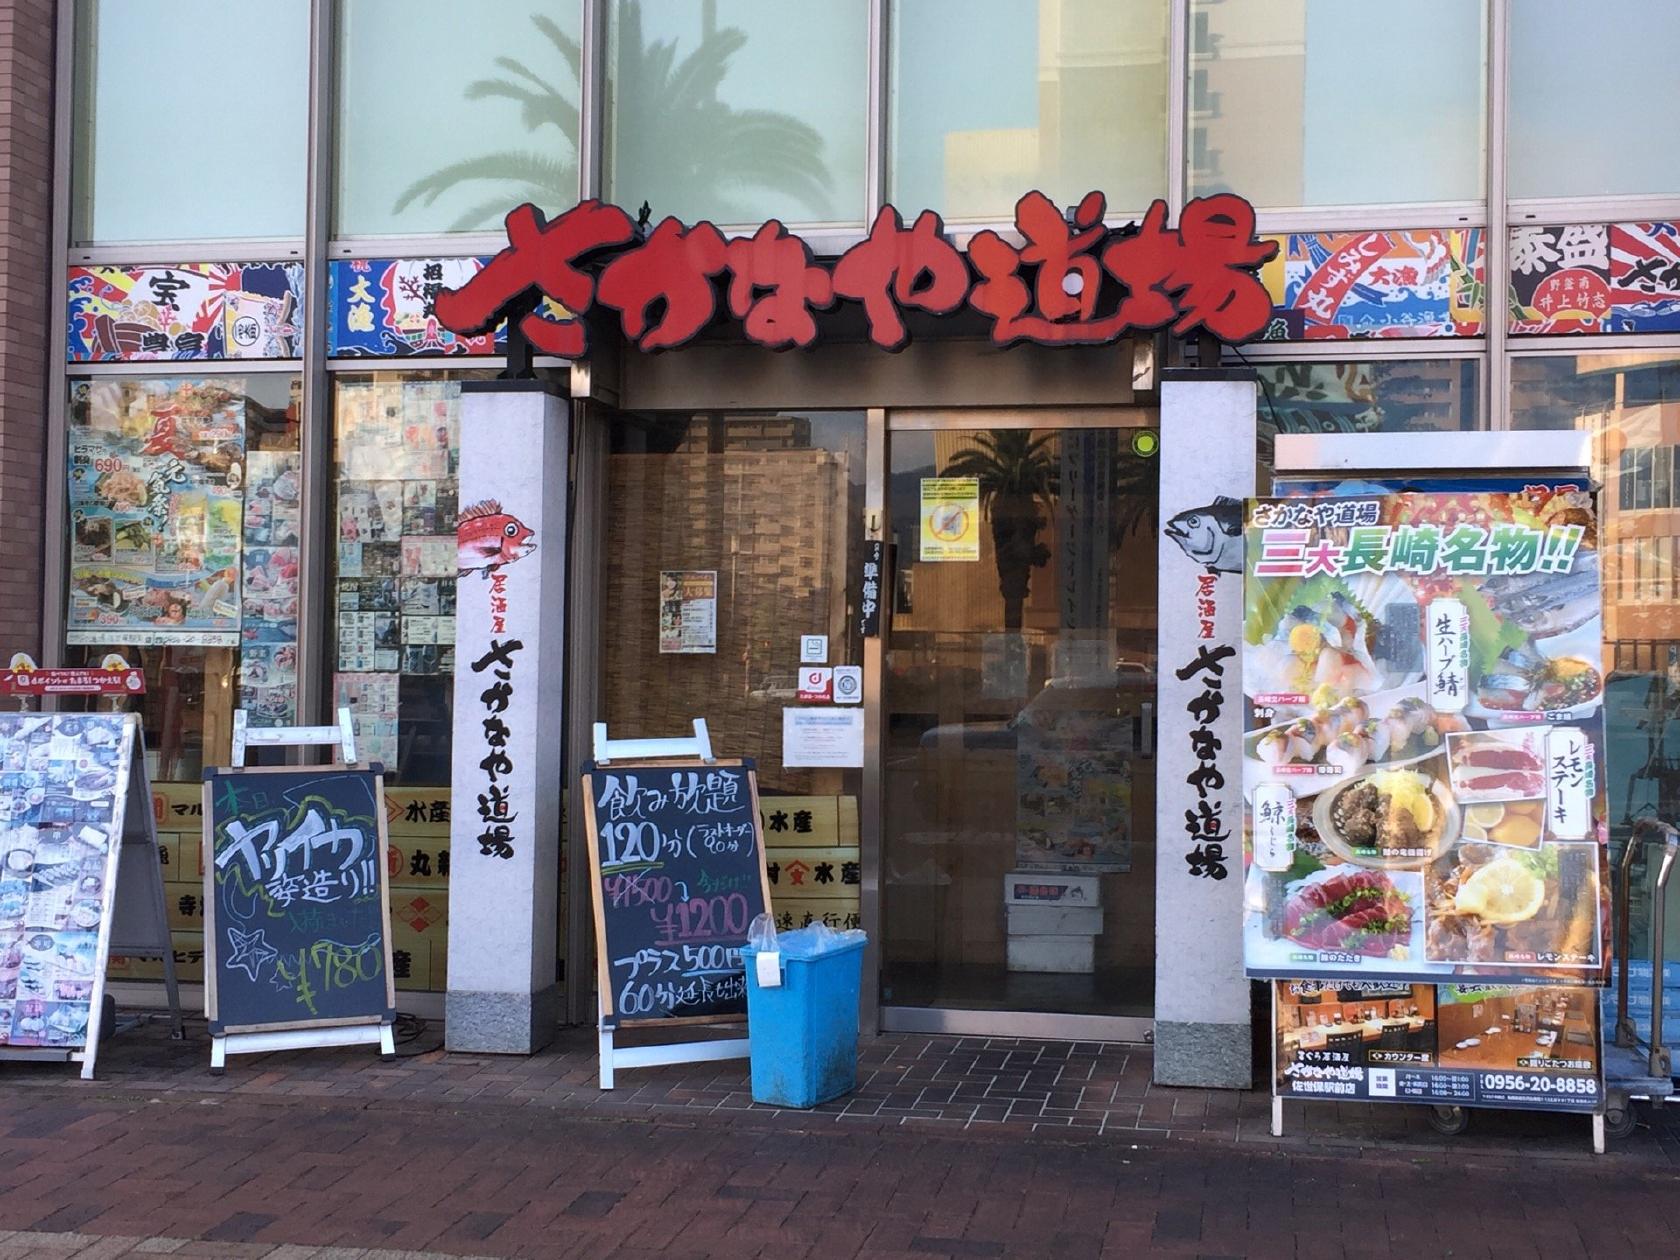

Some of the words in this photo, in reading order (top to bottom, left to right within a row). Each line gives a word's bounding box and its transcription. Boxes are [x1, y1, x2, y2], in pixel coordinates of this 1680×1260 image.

[149, 271, 190, 311] 宝
[435, 190, 1276, 357] さかなや道場
[1253, 502, 1379, 526] さかなや道場
[489, 574, 508, 633] 居酒屋
[863, 562, 879, 619] 準備中
[1195, 575, 1216, 639] 居酒屋
[1433, 613, 1460, 697] 生ハーブ鯖
[471, 639, 524, 860] さかなや道場
[1175, 644, 1237, 881] さかなや道場
[405, 800, 450, 823] 水産
[598, 769, 746, 820] 飲み放題
[769, 810, 813, 833] 水産
[1484, 1073, 1597, 1095] 0956-20-8858
